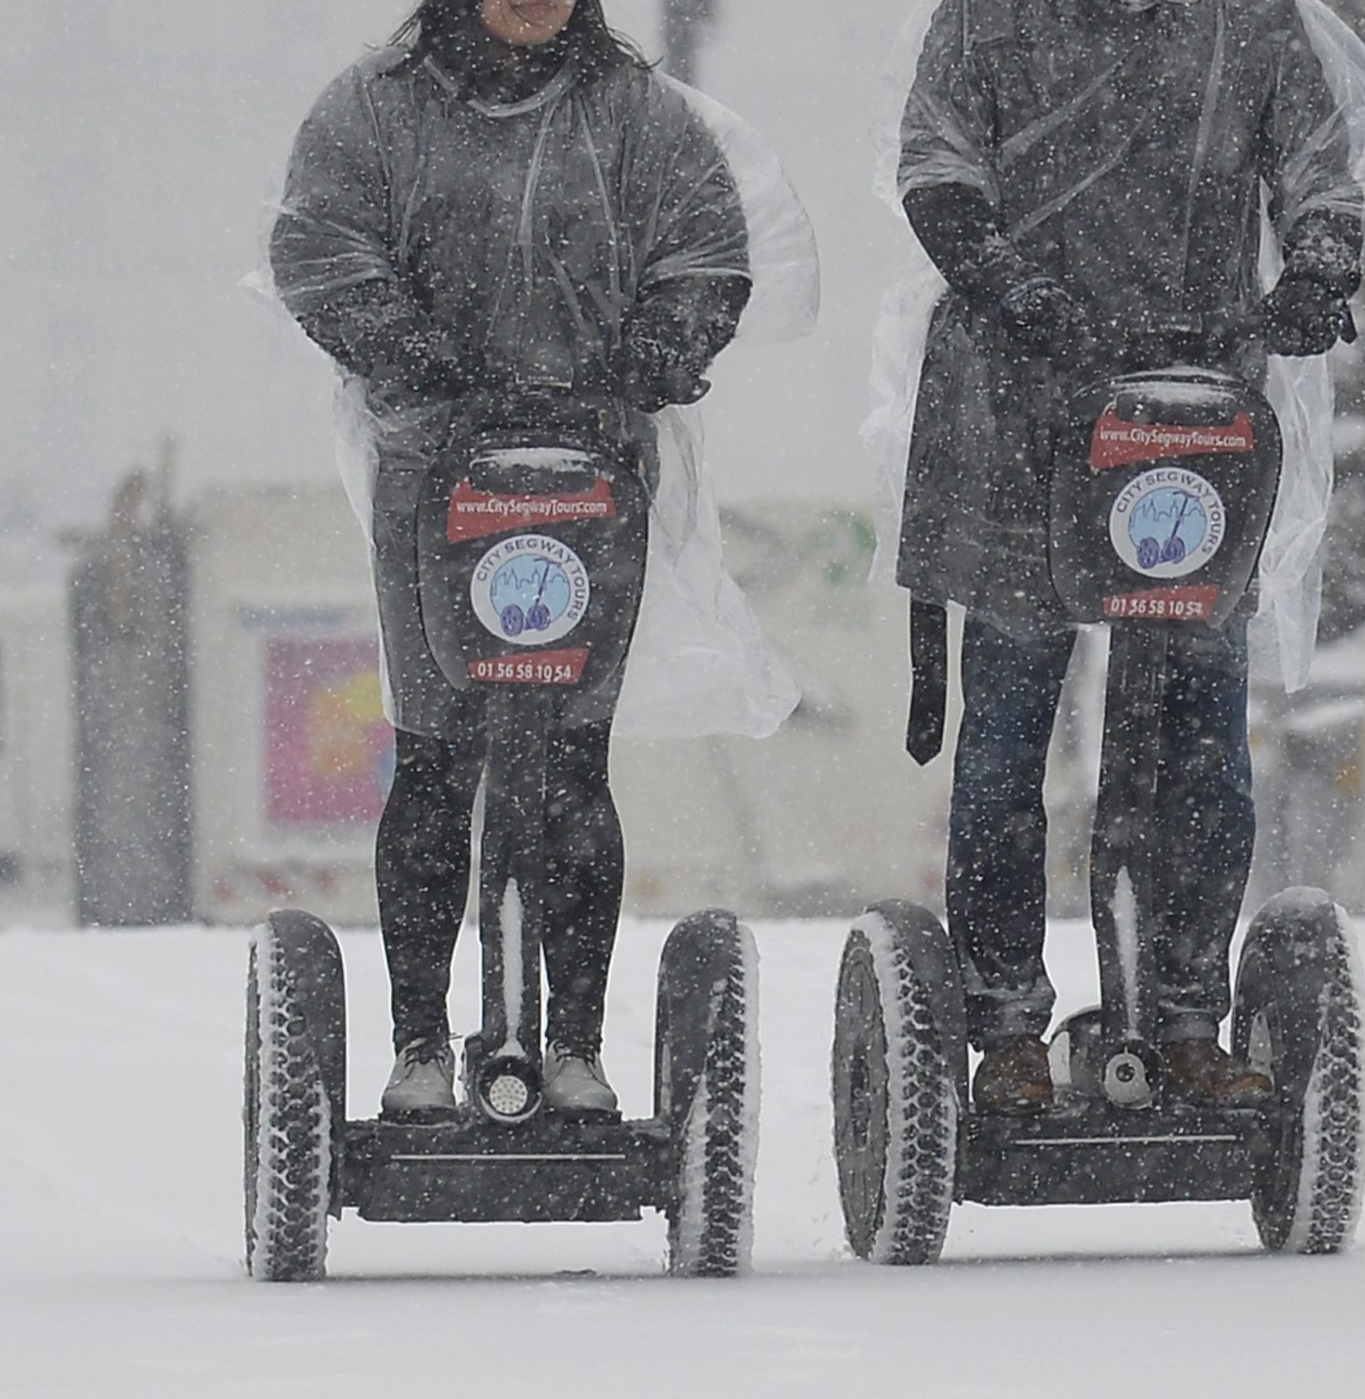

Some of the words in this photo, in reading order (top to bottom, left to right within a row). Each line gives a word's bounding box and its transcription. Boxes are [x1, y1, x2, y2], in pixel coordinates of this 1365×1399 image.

[1100, 428, 1246, 448] www.CitySegwayTours.com
[456, 499, 607, 516] www.CitySegwayTours.com
[1116, 481, 1143, 514] CITY
[1145, 471, 1214, 499] SEGWAY
[1201, 501, 1223, 554] TOURS
[476, 549, 503, 582] CITY
[504, 538, 575, 564] SEGWAY
[567, 567, 587, 621] TOURS
[1110, 598, 1126, 612] 01
[1149, 600, 1165, 613] 58
[1168, 601, 1184, 614] 10
[477, 662, 493, 677] 01
[497, 663, 514, 678] 56
[516, 664, 533, 678] 58
[537, 664, 553, 680] 10
[555, 664, 572, 680] 54
